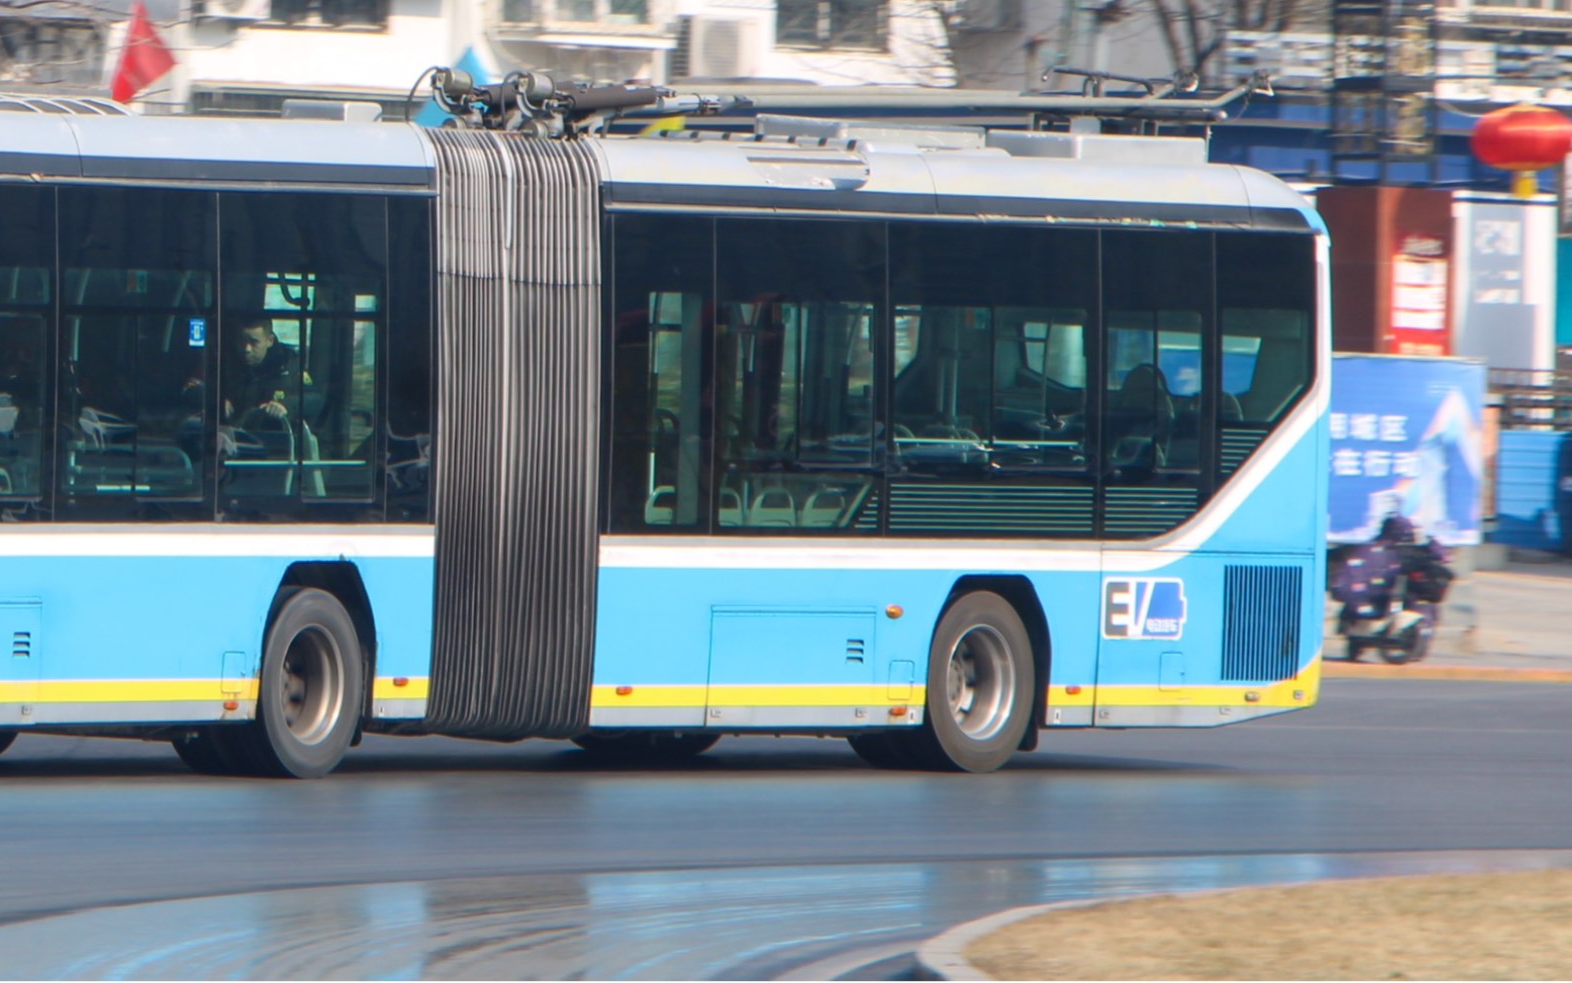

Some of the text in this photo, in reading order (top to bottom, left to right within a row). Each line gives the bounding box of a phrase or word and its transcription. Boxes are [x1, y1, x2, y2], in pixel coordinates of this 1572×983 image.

[1329, 448, 1420, 477] 在行动
[1105, 580, 1155, 636] EV
